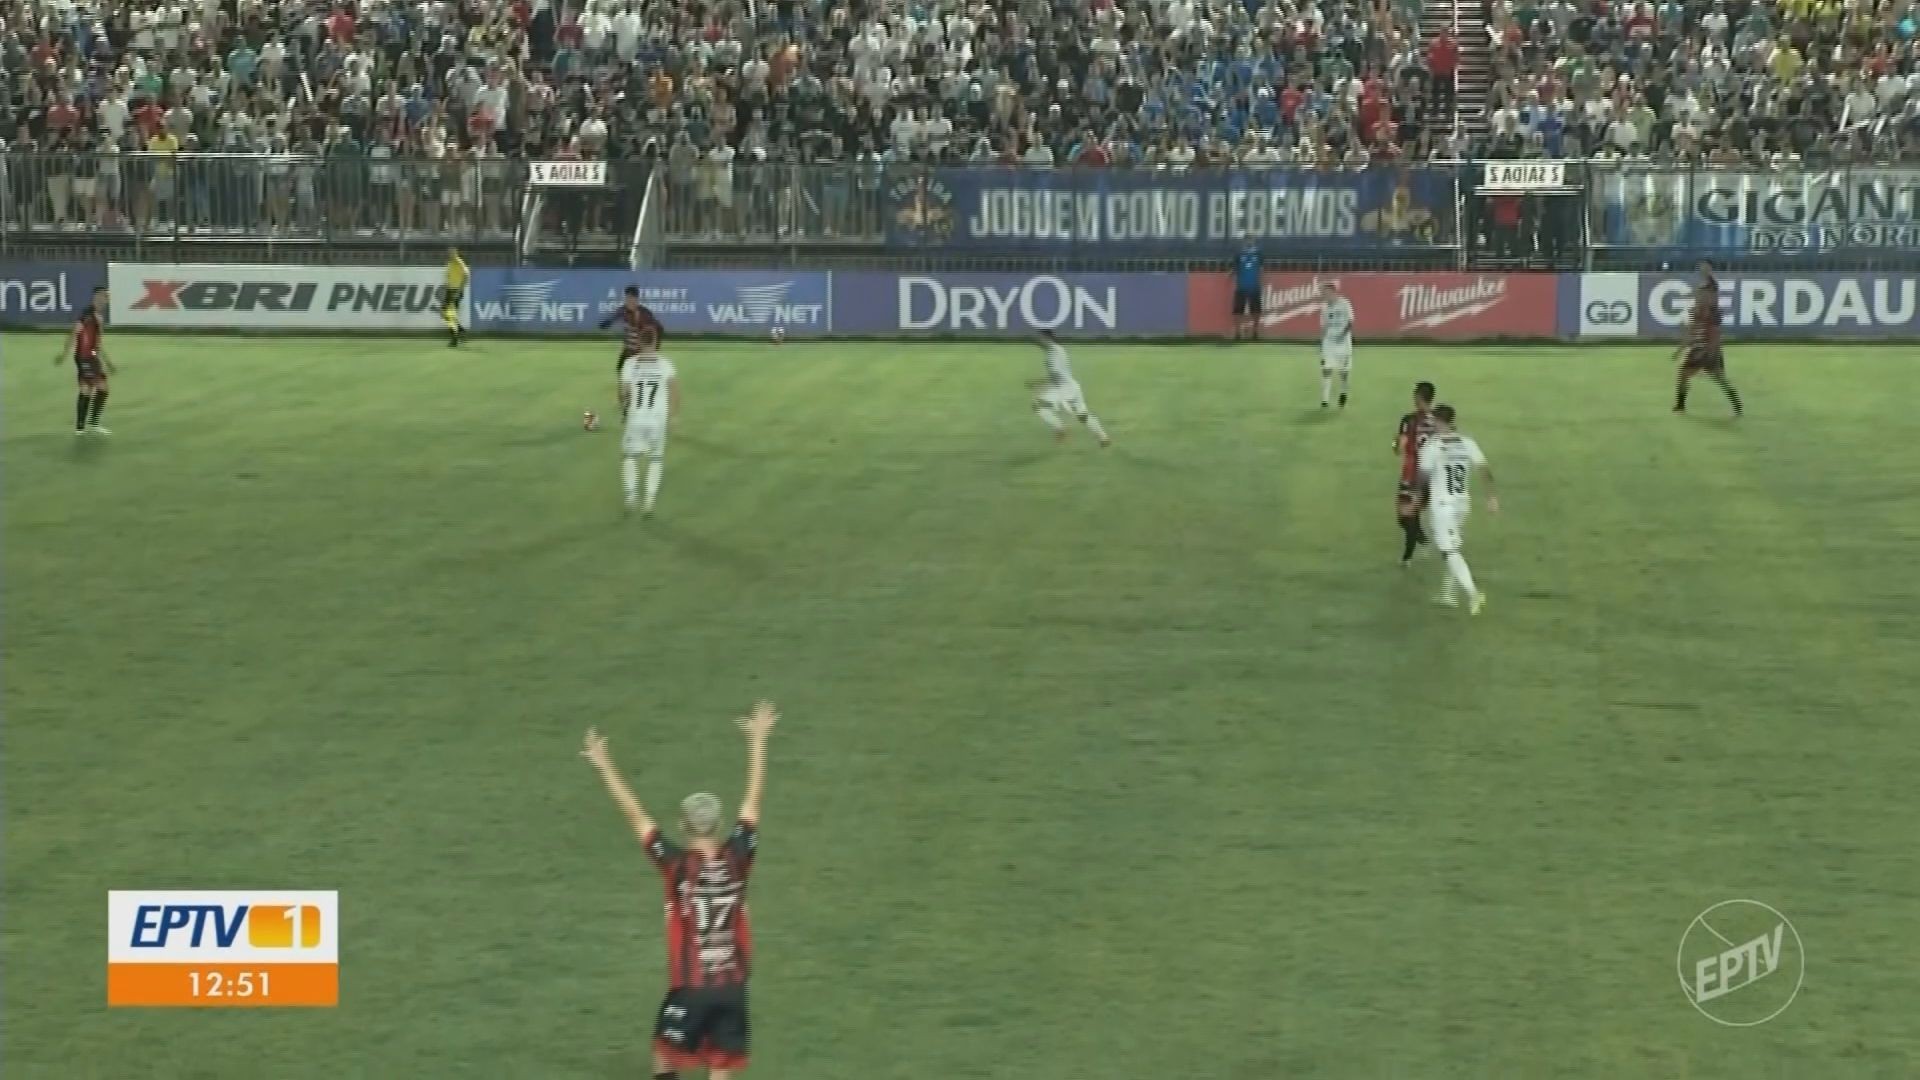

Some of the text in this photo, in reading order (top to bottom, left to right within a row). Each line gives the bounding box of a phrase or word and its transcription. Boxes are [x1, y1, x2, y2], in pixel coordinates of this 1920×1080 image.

[970, 187, 1359, 241] JOGUEM COMO BEBEMOS
[0, 271, 73, 312] nal
[128, 279, 319, 313] XBRI
[1396, 275, 1506, 319] Milwaukee
[1649, 278, 1917, 327] GERDAU
[636, 380, 660, 410] 17
[1445, 463, 1467, 496] 19
[691, 894, 739, 930] 17
